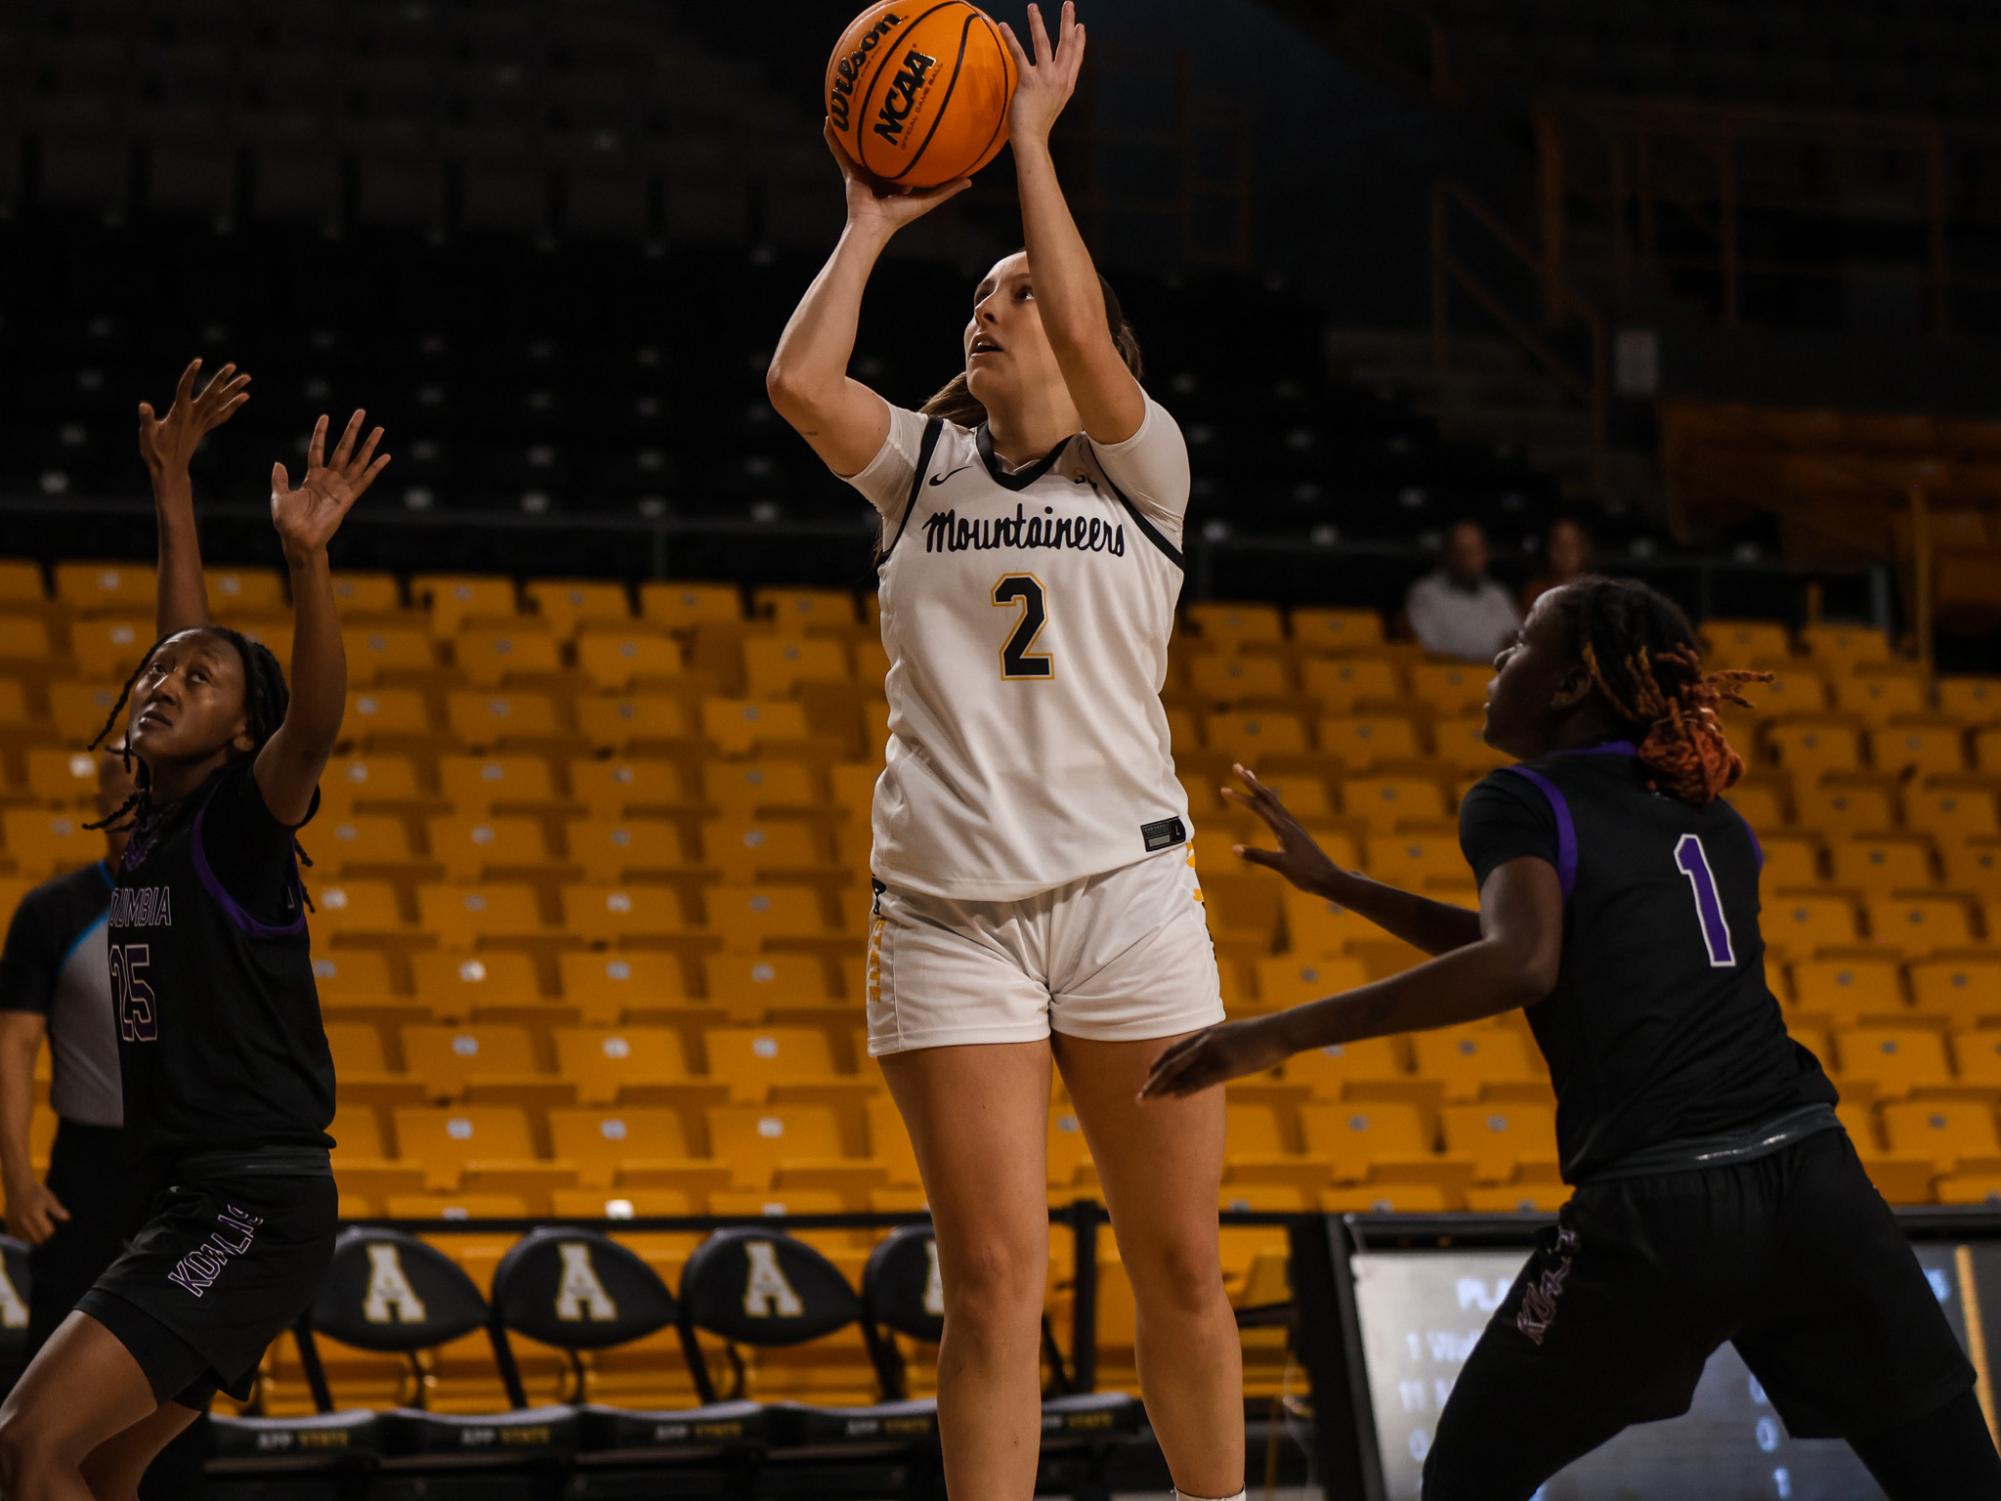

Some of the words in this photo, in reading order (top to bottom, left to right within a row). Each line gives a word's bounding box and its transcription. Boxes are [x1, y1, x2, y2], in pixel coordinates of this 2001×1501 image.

[830, 13, 902, 132] Wilson
[873, 50, 937, 146] NCAA
[922, 503, 1124, 557] Mountaineers
[990, 572, 1056, 681] 2
[1673, 832, 1737, 968] 1
[109, 943, 159, 1042] 25
[362, 1242, 428, 1325] A
[553, 1241, 619, 1322] A
[742, 1239, 806, 1319] A
